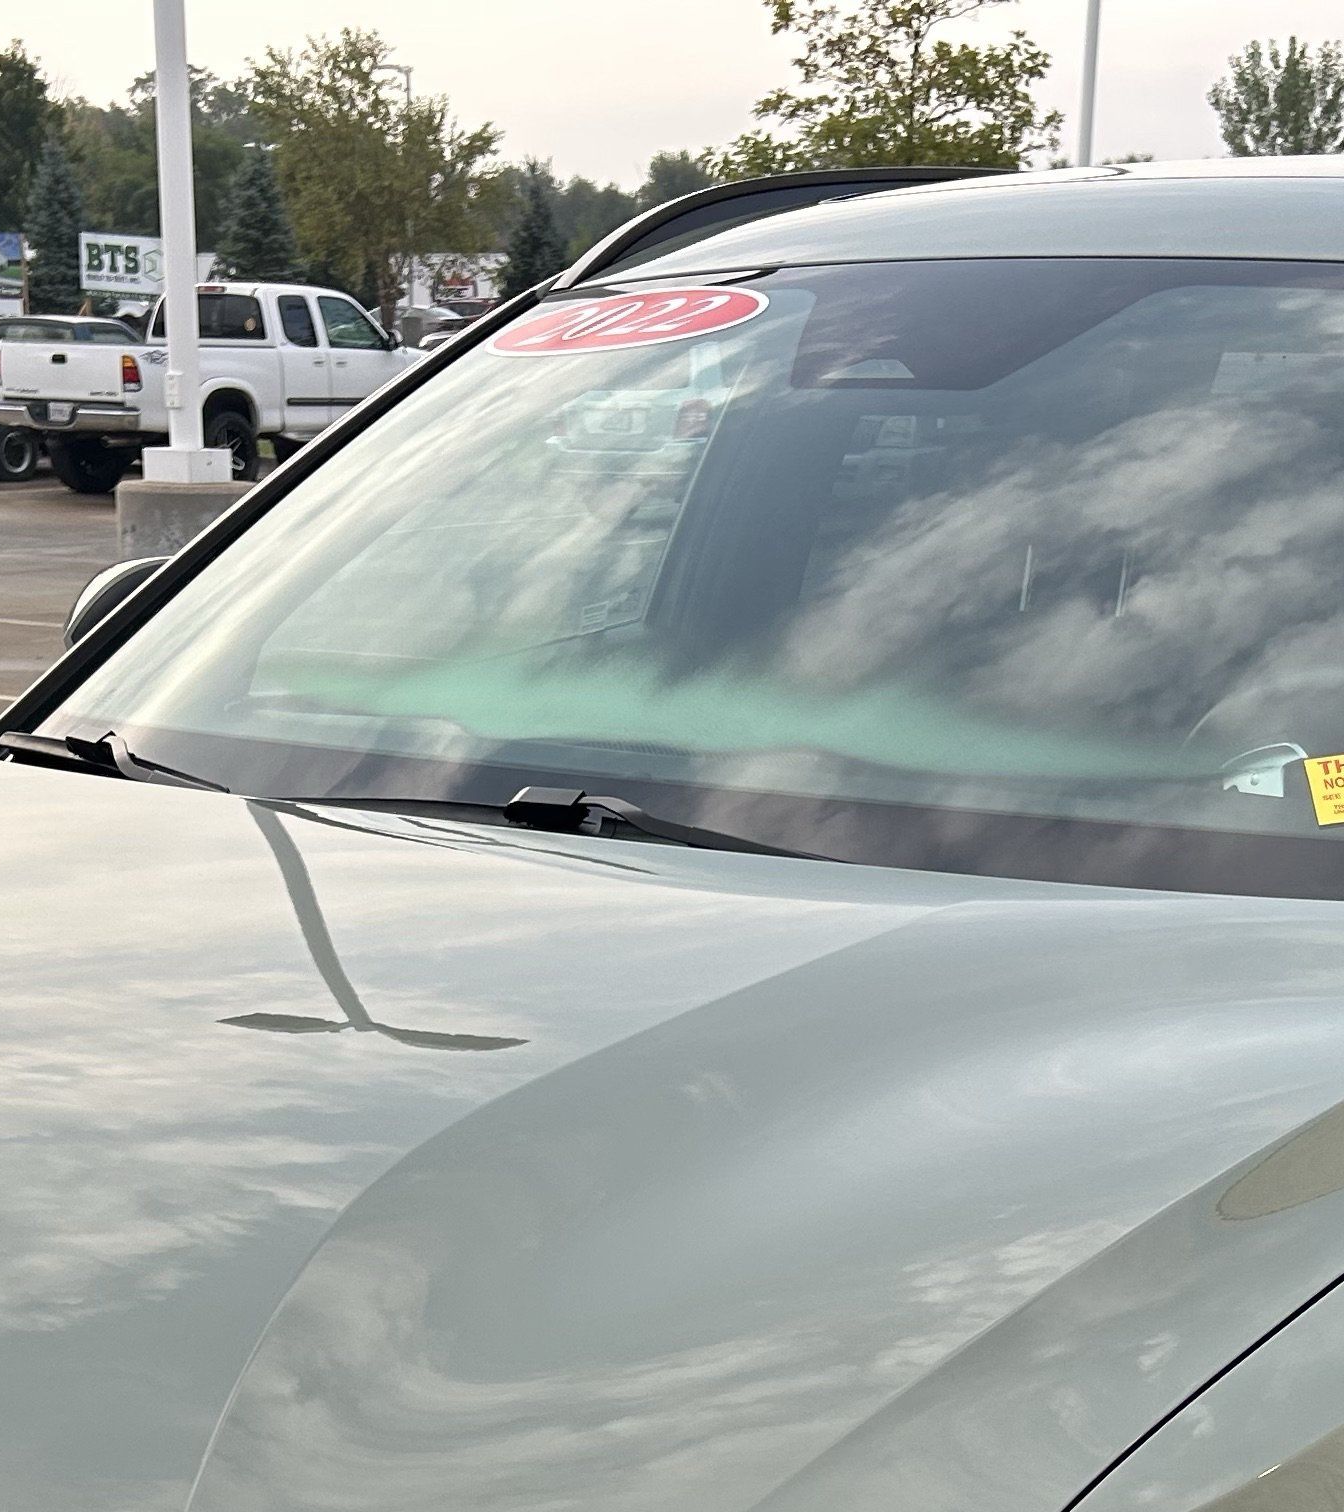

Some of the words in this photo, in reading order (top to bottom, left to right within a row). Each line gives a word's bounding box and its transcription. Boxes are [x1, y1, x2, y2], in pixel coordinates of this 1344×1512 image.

[86, 243, 141, 274] BTS
[511, 294, 732, 347] 2022
[1322, 792, 1342, 801] SEE
